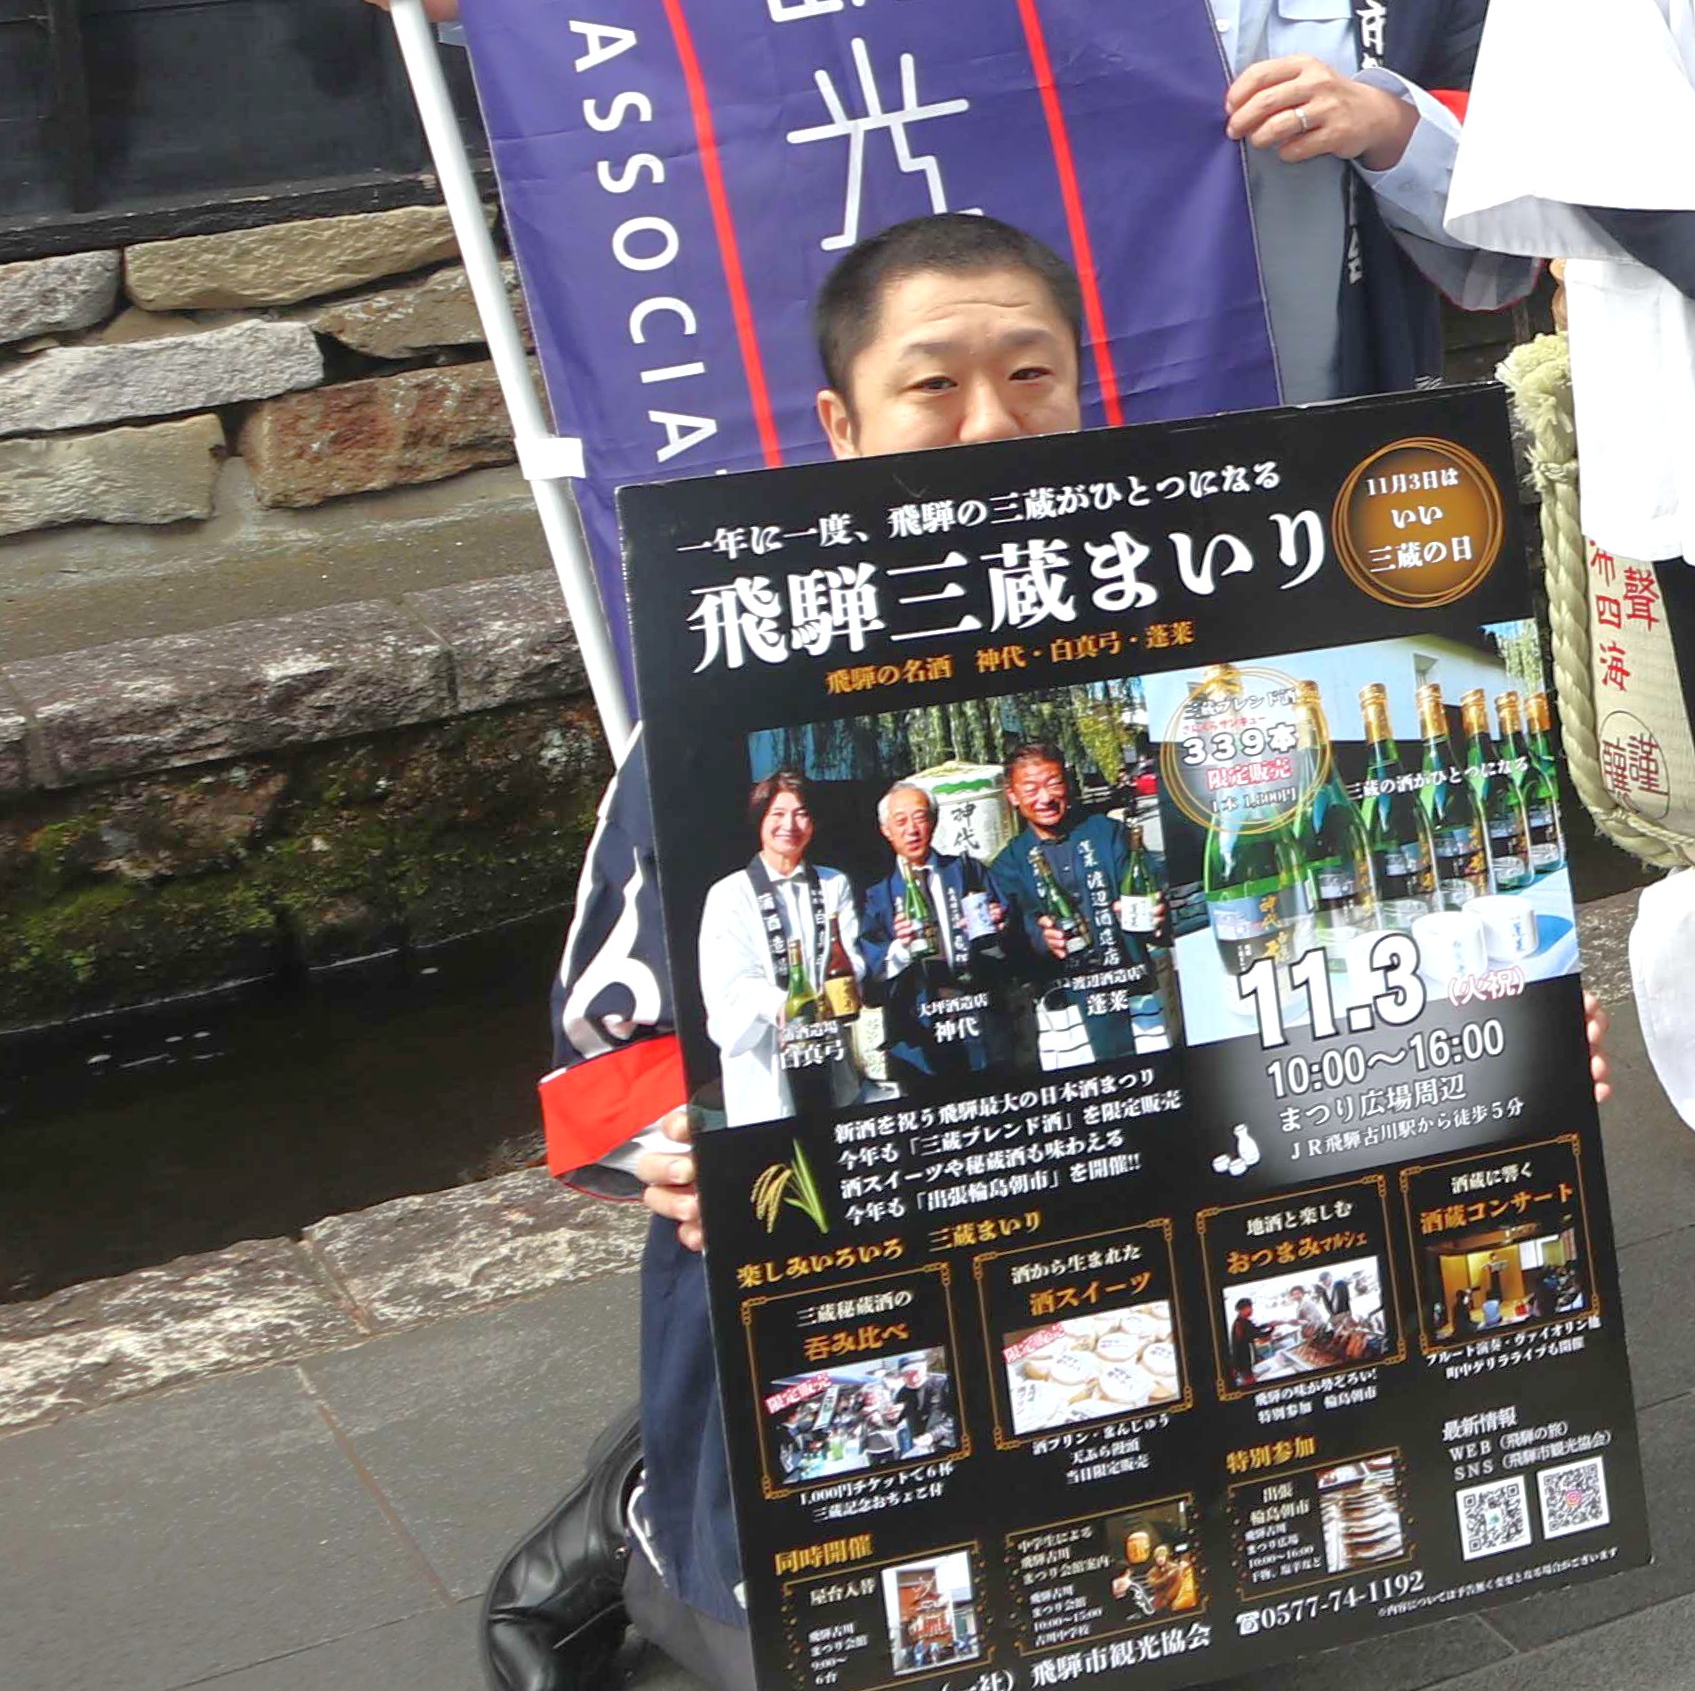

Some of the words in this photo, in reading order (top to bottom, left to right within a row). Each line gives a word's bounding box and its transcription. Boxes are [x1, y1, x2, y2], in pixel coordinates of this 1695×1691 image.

[568, 18, 727, 476] ASSOCIA
[1364, 467, 1460, 497] 11月3日は
[676, 460, 1283, 562] 一年に一度、飛騨の三蔵がひとつになる
[1390, 503, 1444, 529] いい
[1367, 535, 1474, 575] 三蔵の日
[685, 508, 1327, 675] 飛騨三蔵まいり
[824, 653, 955, 696] 飛騨の名酒
[1182, 721, 1298, 767] 339本
[1207, 757, 1292, 791] 限定販売
[1345, 755, 1529, 801] 三蔵の酒がひとつになる
[1238, 932, 1426, 1050] 11.3
[933, 1017, 980, 1044] 神代
[833, 1067, 1156, 1145] 新酒を祝う飛騨最大の日本酒まつり
[1278, 1073, 1467, 1133] まつり広場周辺
[837, 1089, 1183, 1171] 今年も「三蔵ブレンド酒」を限定販売
[840, 1127, 1126, 1201] 酒スイーツや秘蔵酒も味わえる
[1246, 1198, 1353, 1237] 地酒と楽しむ
[1419, 1182, 1574, 1236] 酒蔵コンサート
[736, 1238, 904, 1289] 楽しみいろいろ
[928, 1211, 1043, 1253] 三蔵まいり
[1011, 1243, 1143, 1285] 酒から生まれた
[1226, 1229, 1368, 1275] おつまみマルシェ
[796, 1289, 914, 1327] 三蔵秘蔵酒の
[1029, 1270, 1152, 1317] 酒スイーツ
[803, 1321, 911, 1363] 呑み比べ
[1442, 1406, 1518, 1441] 最新情報
[1226, 1435, 1317, 1474] 特別参加
[775, 1533, 875, 1577] 同時開催
[1261, 1570, 1426, 1631] 0577-74-1192
[1030, 1622, 1213, 1688] 飛騨市観光協会
